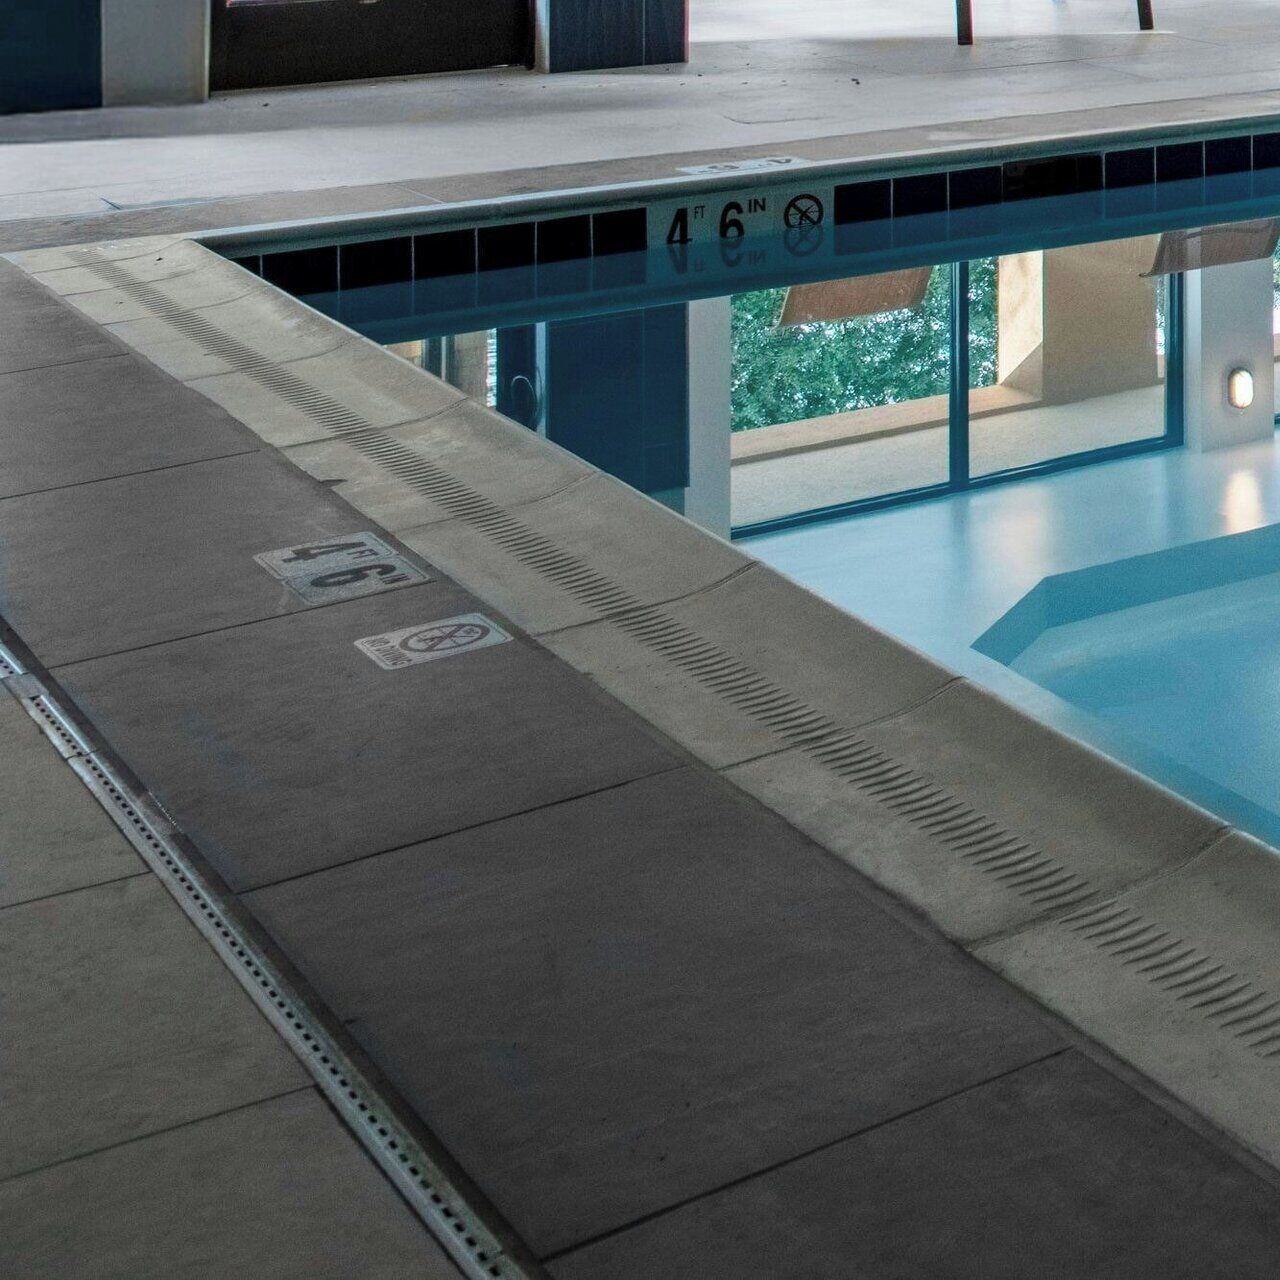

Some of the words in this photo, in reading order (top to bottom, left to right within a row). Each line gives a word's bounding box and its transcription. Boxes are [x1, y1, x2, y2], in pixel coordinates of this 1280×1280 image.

[666, 208, 693, 244] 4
[694, 205, 705, 219] FT
[719, 201, 744, 239] 6
[748, 197, 767, 213] IN
[282, 541, 367, 563] 4
[346, 548, 379, 560] FT
[310, 563, 397, 588] 6
